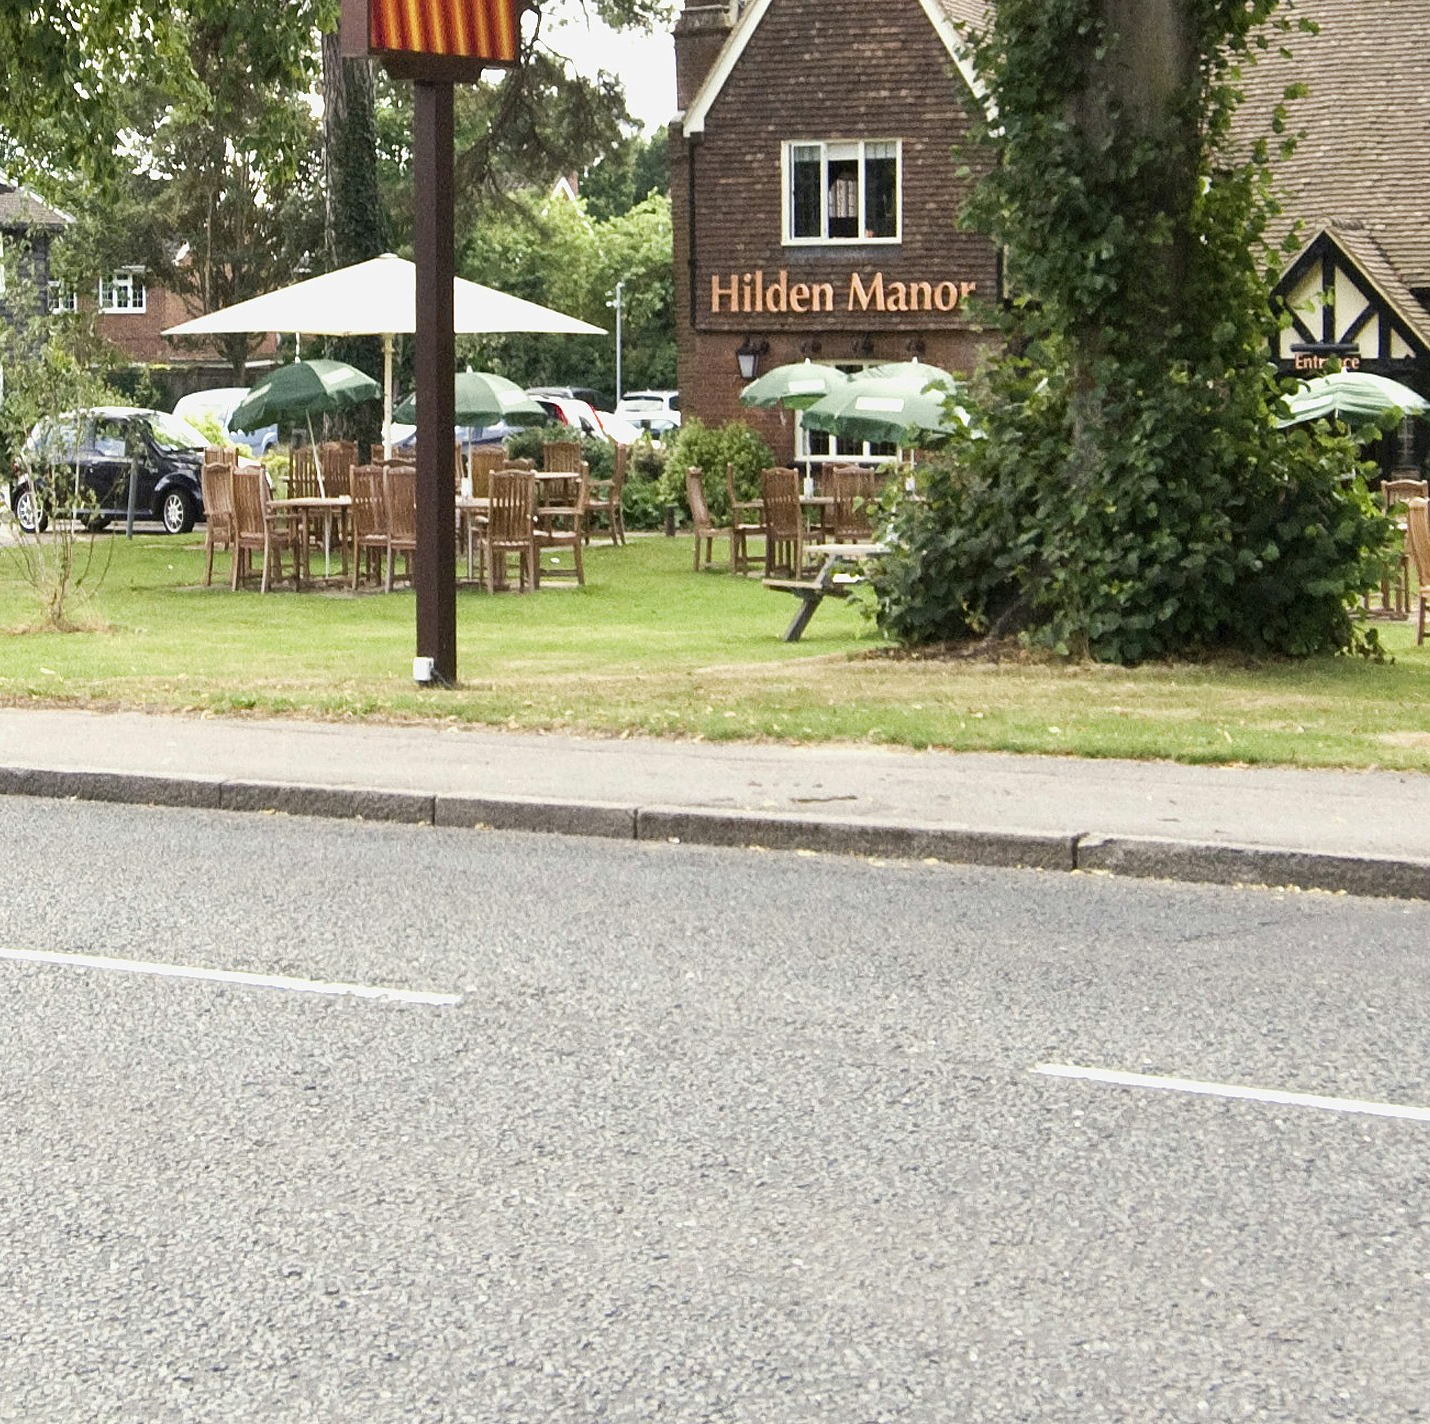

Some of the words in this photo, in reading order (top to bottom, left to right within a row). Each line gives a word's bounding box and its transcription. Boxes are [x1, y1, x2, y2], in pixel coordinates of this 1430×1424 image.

[711, 270, 834, 313] Hilden
[847, 272, 977, 312] Manor
[1295, 354, 1360, 370] Entrce
